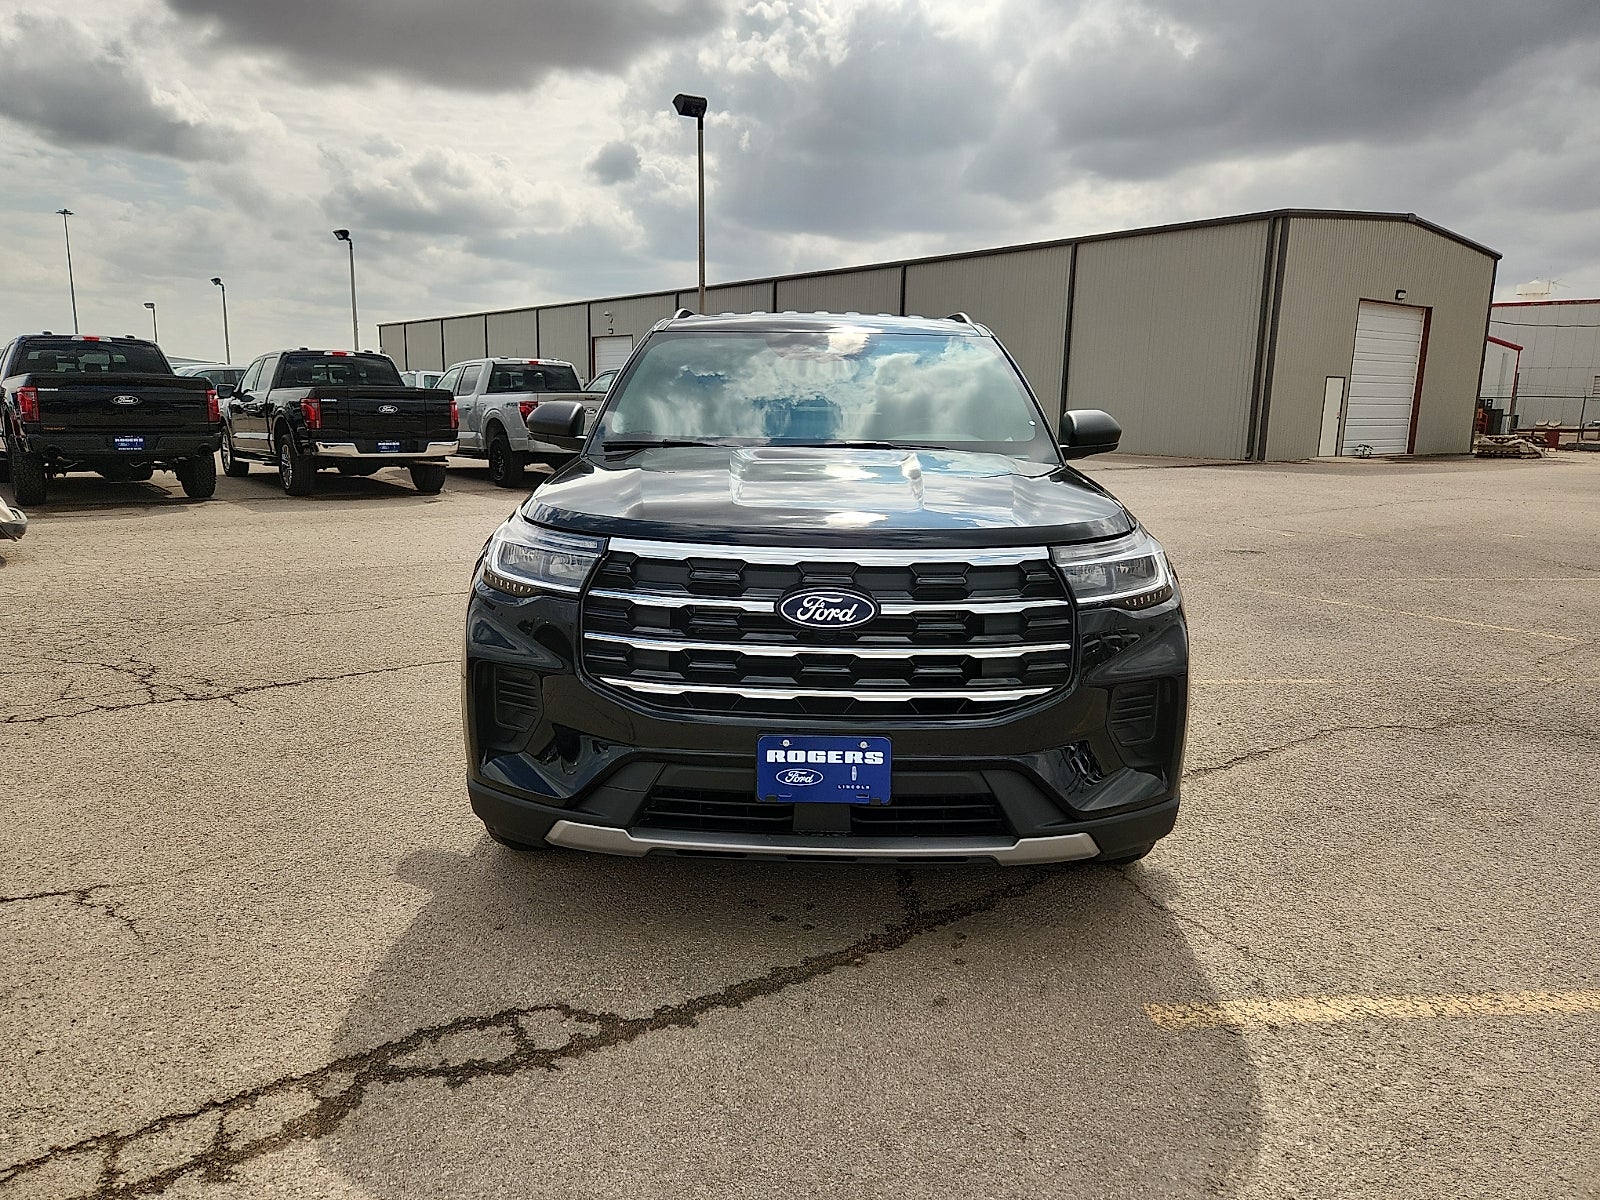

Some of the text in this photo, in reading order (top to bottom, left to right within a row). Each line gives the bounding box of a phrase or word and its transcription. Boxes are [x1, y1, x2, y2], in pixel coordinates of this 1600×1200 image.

[796, 596, 858, 622] Ford
[766, 750, 884, 765] ROGERS
[784, 770, 814, 784] Ford
